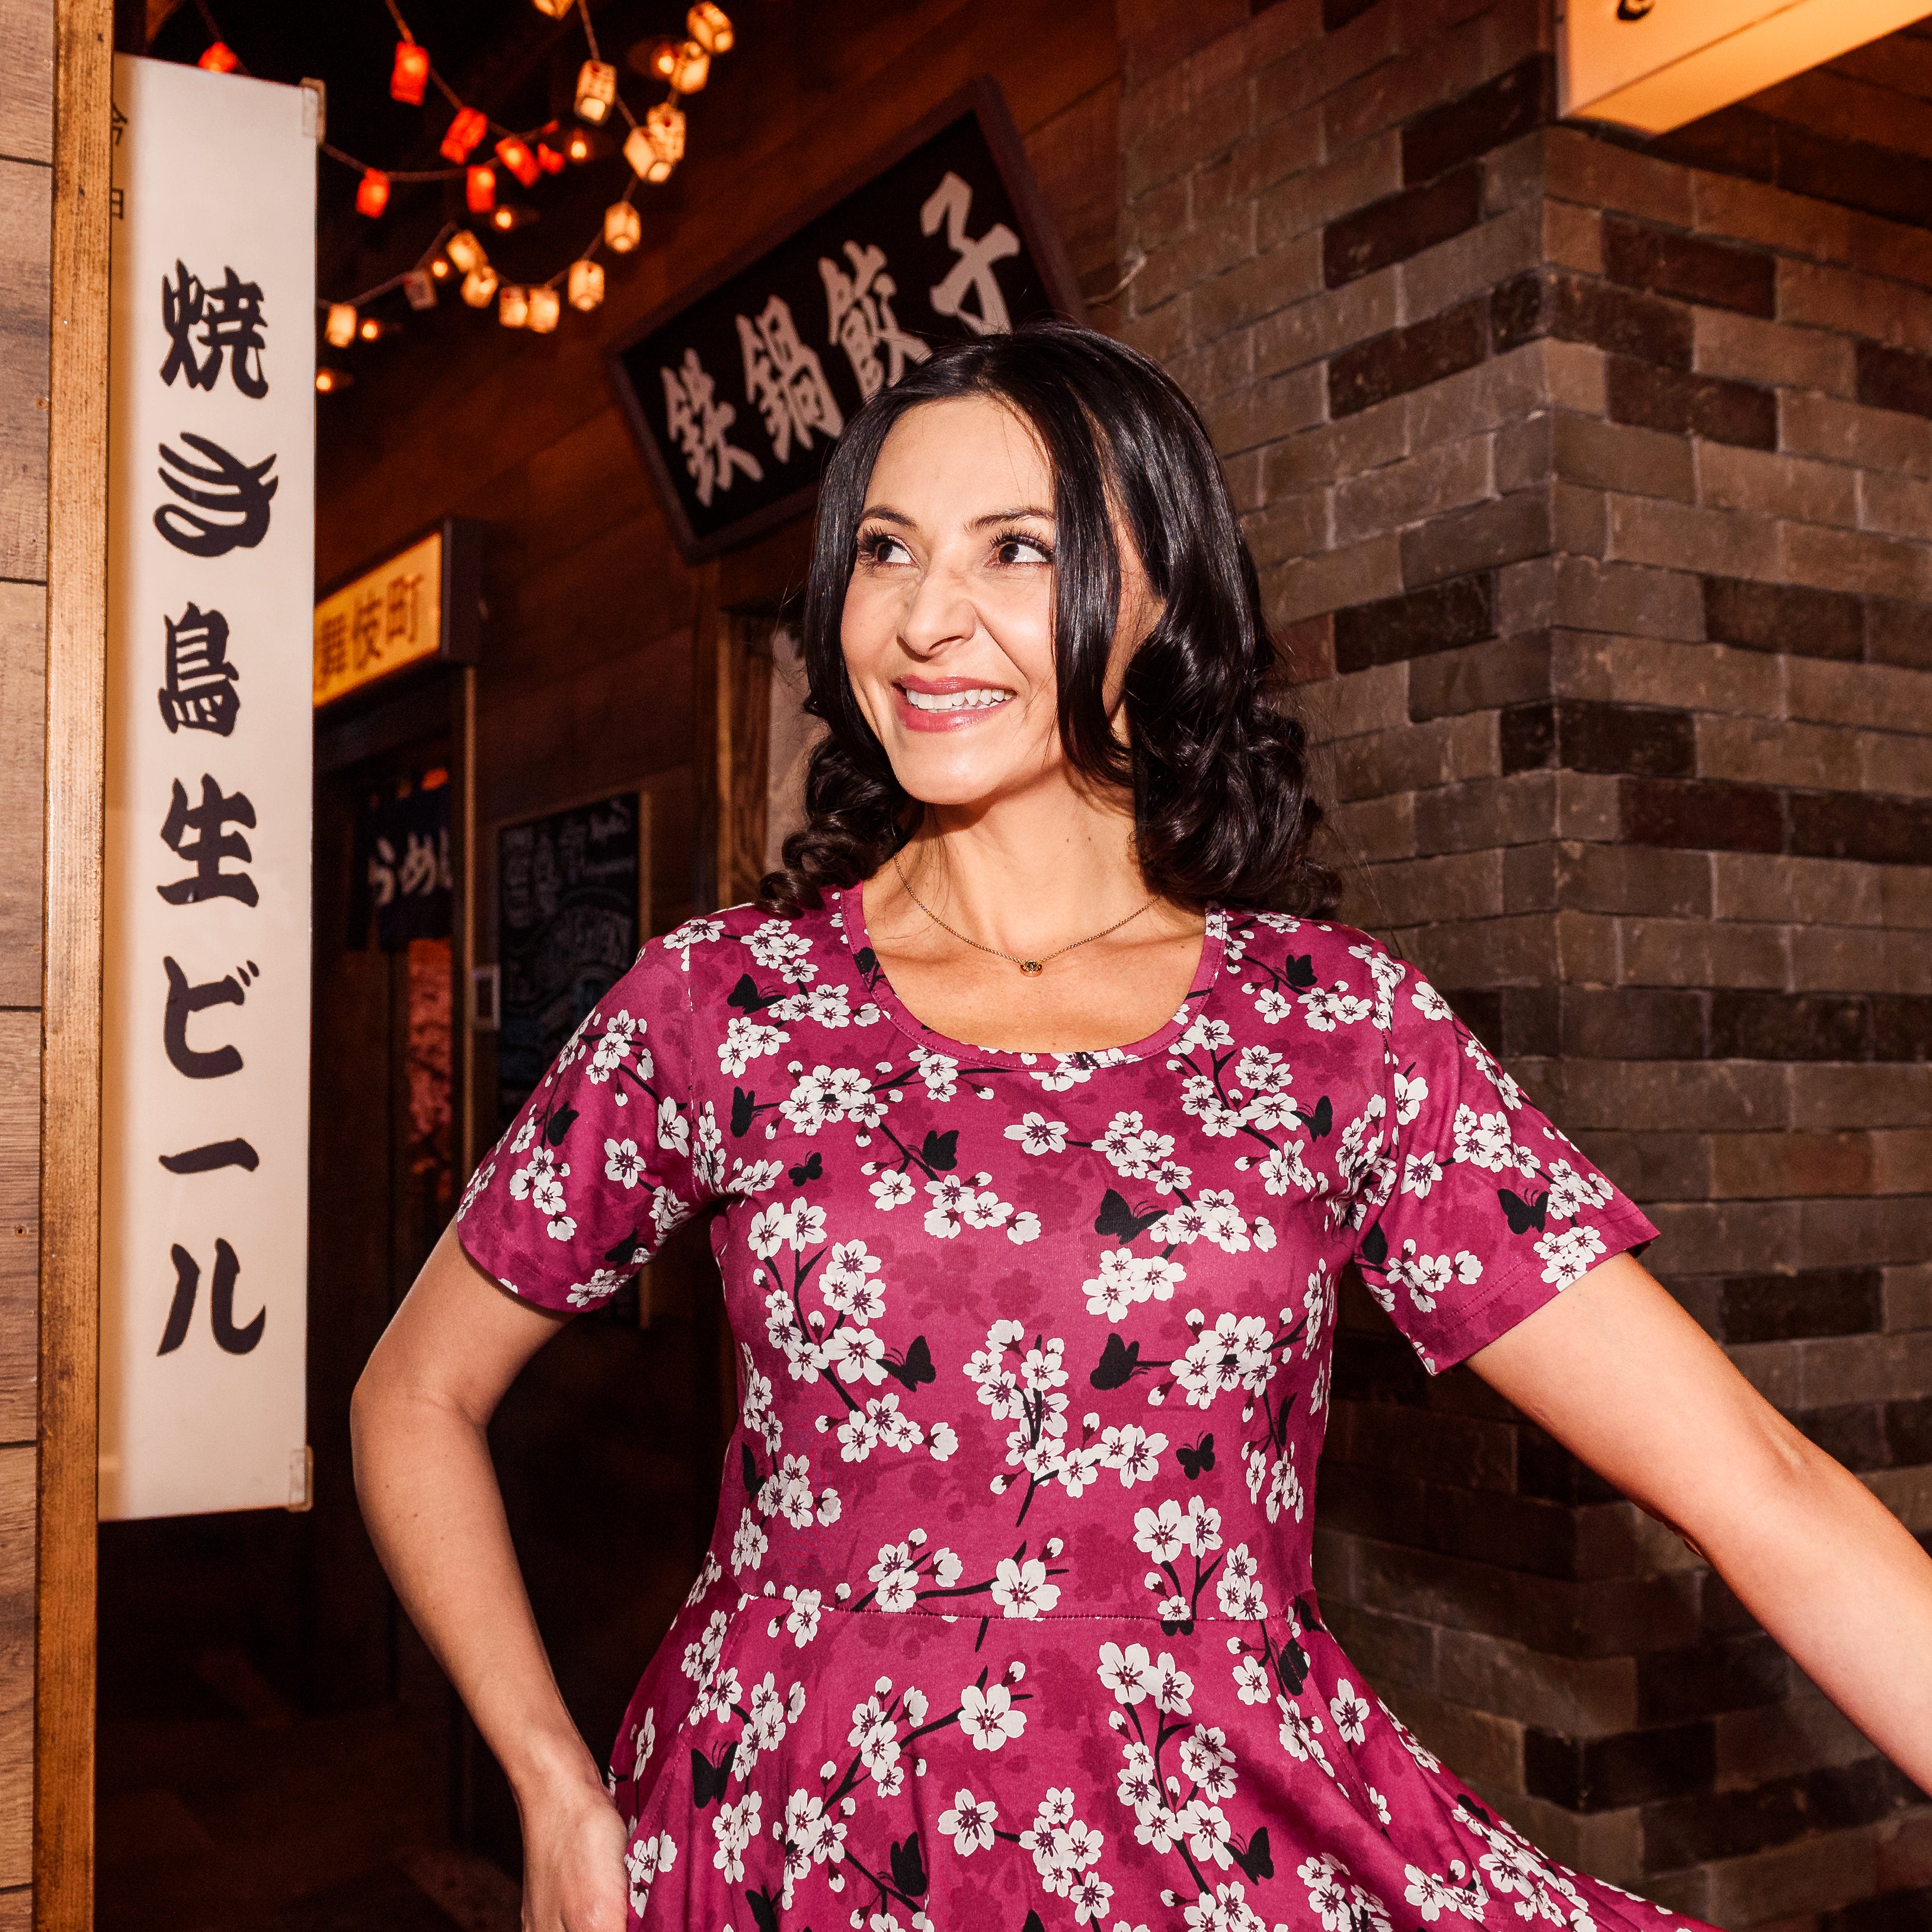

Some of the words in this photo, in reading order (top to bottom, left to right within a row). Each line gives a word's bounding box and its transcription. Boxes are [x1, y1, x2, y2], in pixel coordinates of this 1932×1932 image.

[153, 257, 279, 1357] 焼き鳥生ビール
